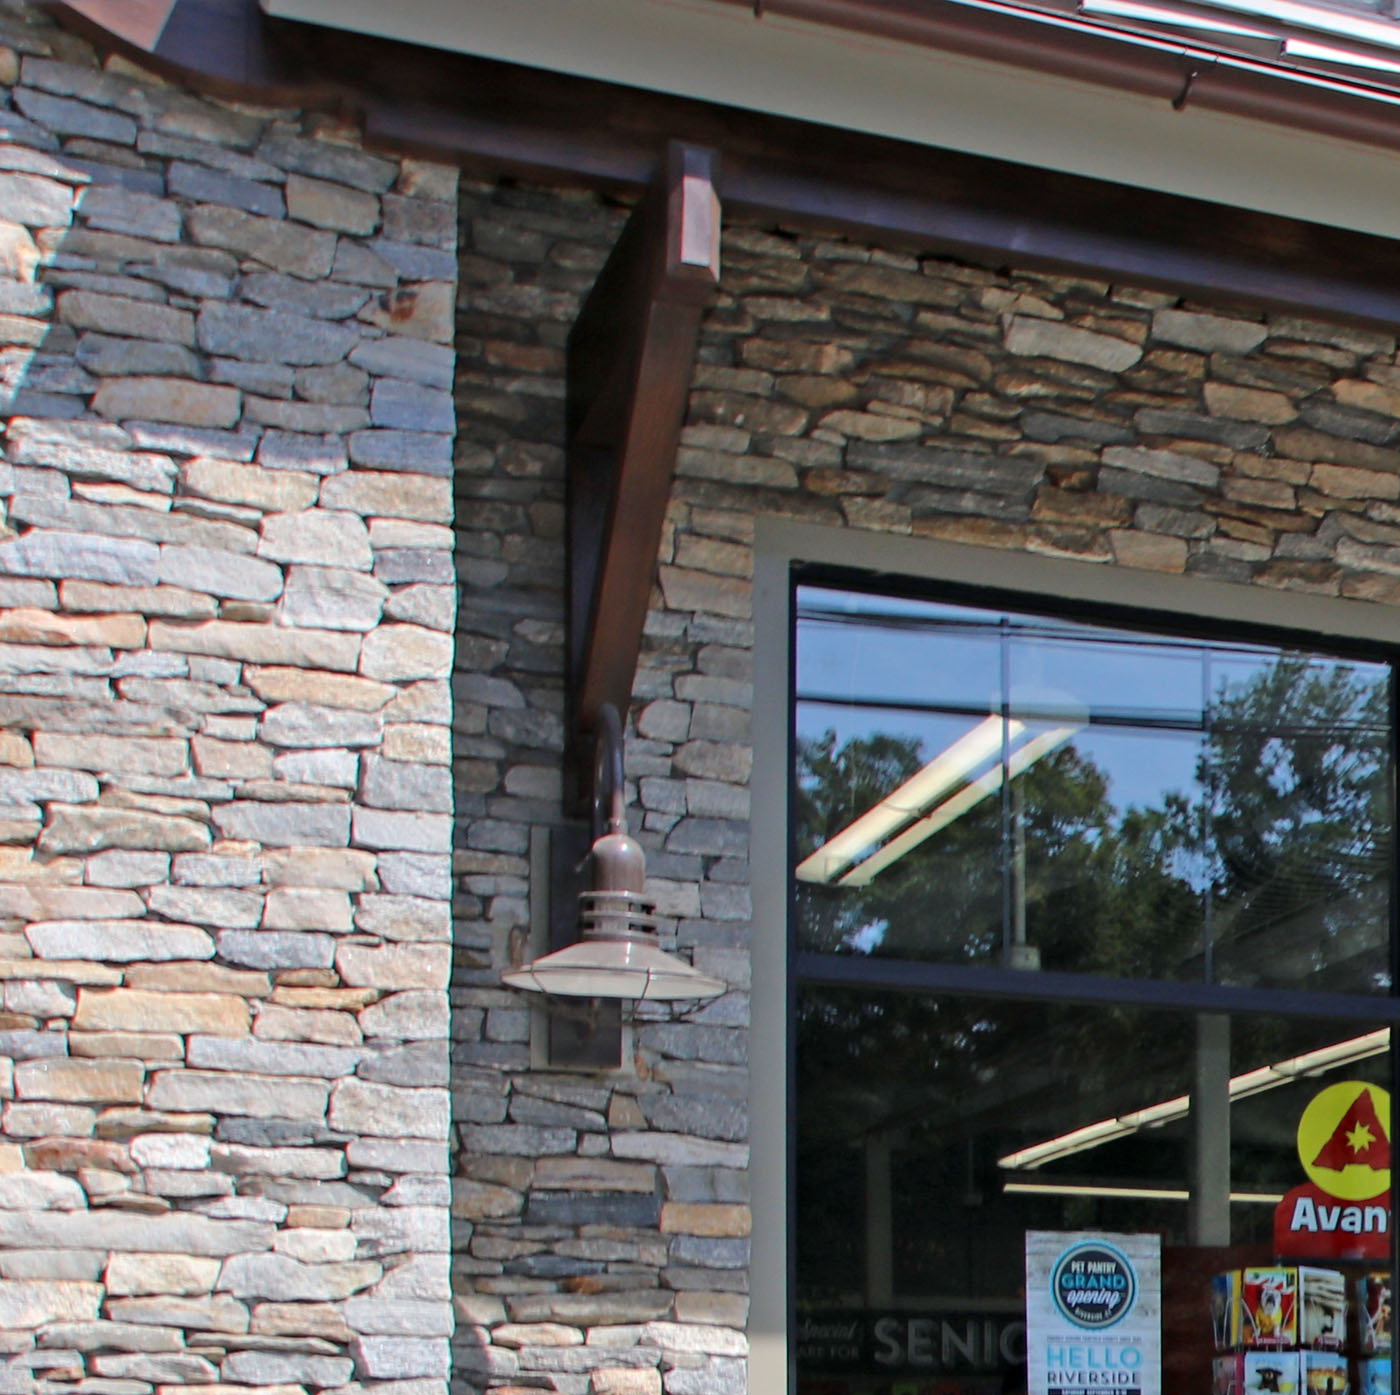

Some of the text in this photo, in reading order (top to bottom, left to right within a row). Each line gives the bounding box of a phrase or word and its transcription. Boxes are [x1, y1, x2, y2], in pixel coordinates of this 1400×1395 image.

[1290, 1197, 1391, 1233] Avan
[1071, 1261, 1117, 1274] PET PANTRY
[1061, 1272, 1126, 1289] GRAND
[1066, 1288, 1120, 1309] opening
[1046, 1346, 1143, 1369] HELLO
[1048, 1371, 1140, 1385] RIVERSIDE
